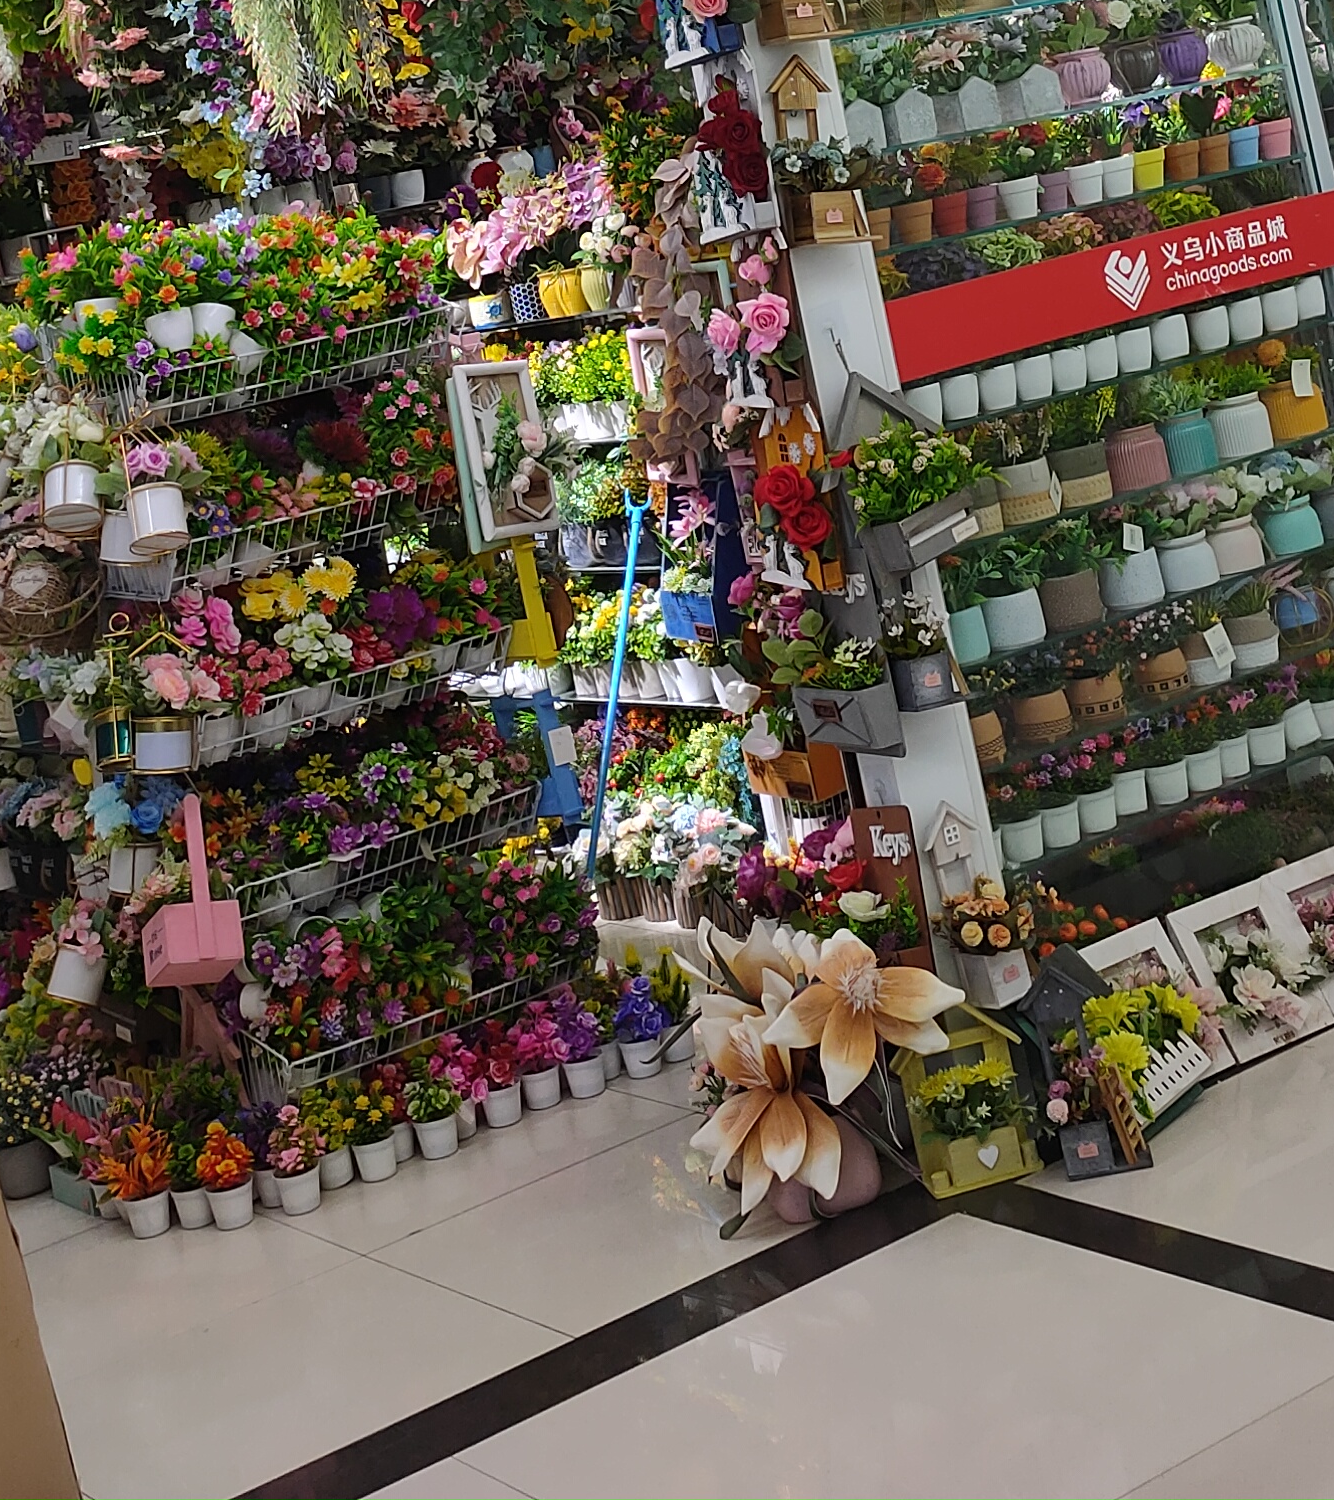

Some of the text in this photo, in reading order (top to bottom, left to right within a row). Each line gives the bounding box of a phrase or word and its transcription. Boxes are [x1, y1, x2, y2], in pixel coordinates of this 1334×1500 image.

[1160, 215, 1289, 270] 义乌小商品城
[1166, 247, 1293, 291] chinagoods.com
[869, 824, 912, 866] Keys
